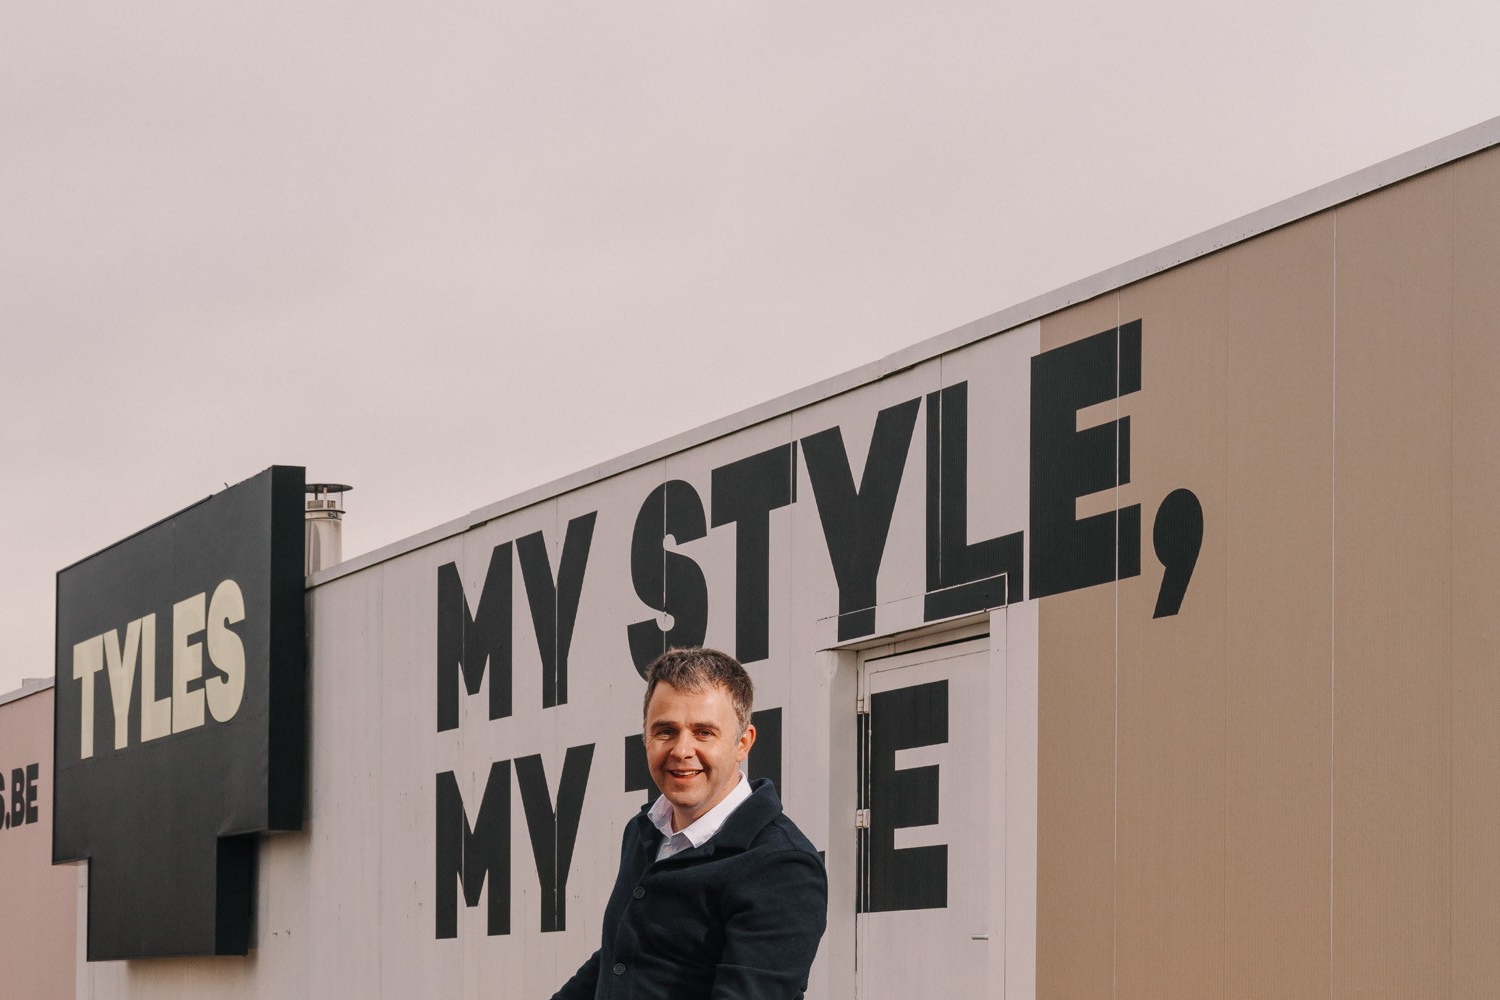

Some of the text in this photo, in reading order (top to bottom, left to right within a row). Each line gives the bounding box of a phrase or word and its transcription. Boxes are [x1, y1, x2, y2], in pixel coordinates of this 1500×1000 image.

[436, 317, 1204, 733] MY STYLE,
[72, 578, 245, 760] TYLES
[435, 744, 596, 939] MY
